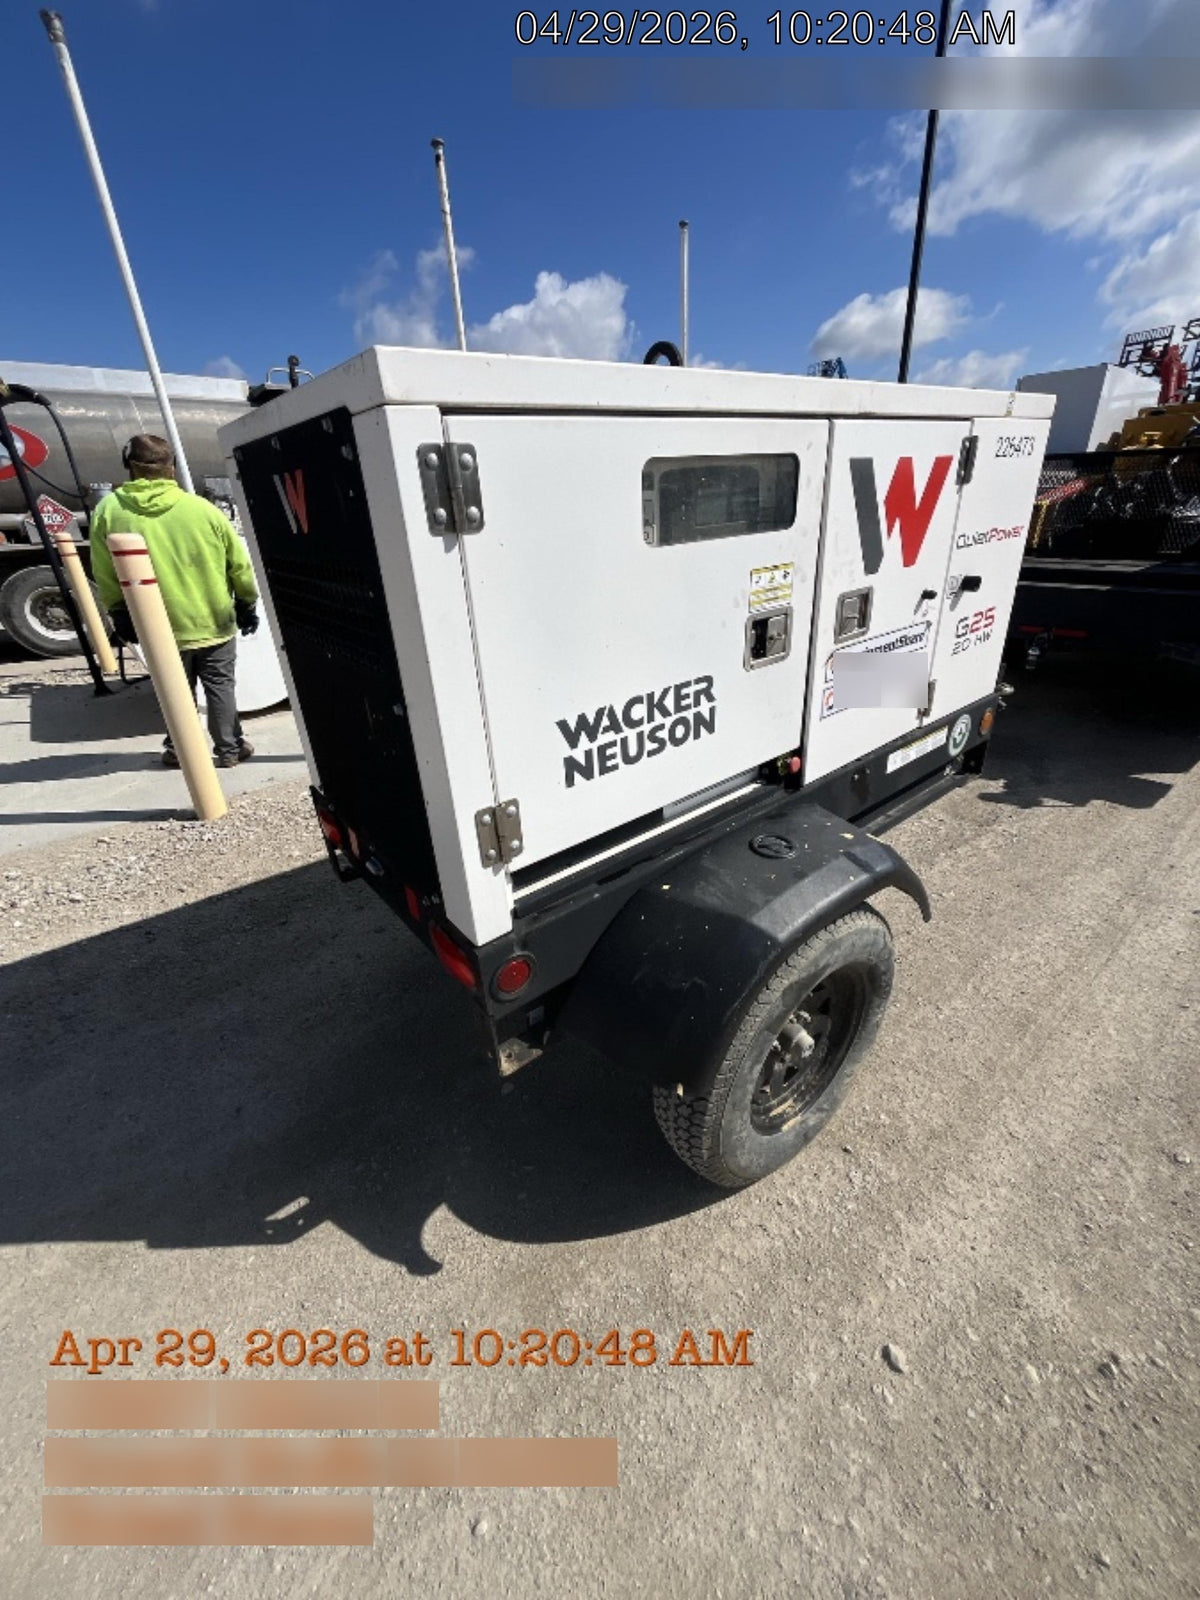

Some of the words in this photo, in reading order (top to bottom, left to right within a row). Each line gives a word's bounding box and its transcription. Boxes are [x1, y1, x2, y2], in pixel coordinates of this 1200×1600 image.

[951, 638, 971, 656] 20
[955, 605, 996, 639] G25
[555, 675, 717, 750] WACKER
[563, 705, 717, 788] NEUSON
